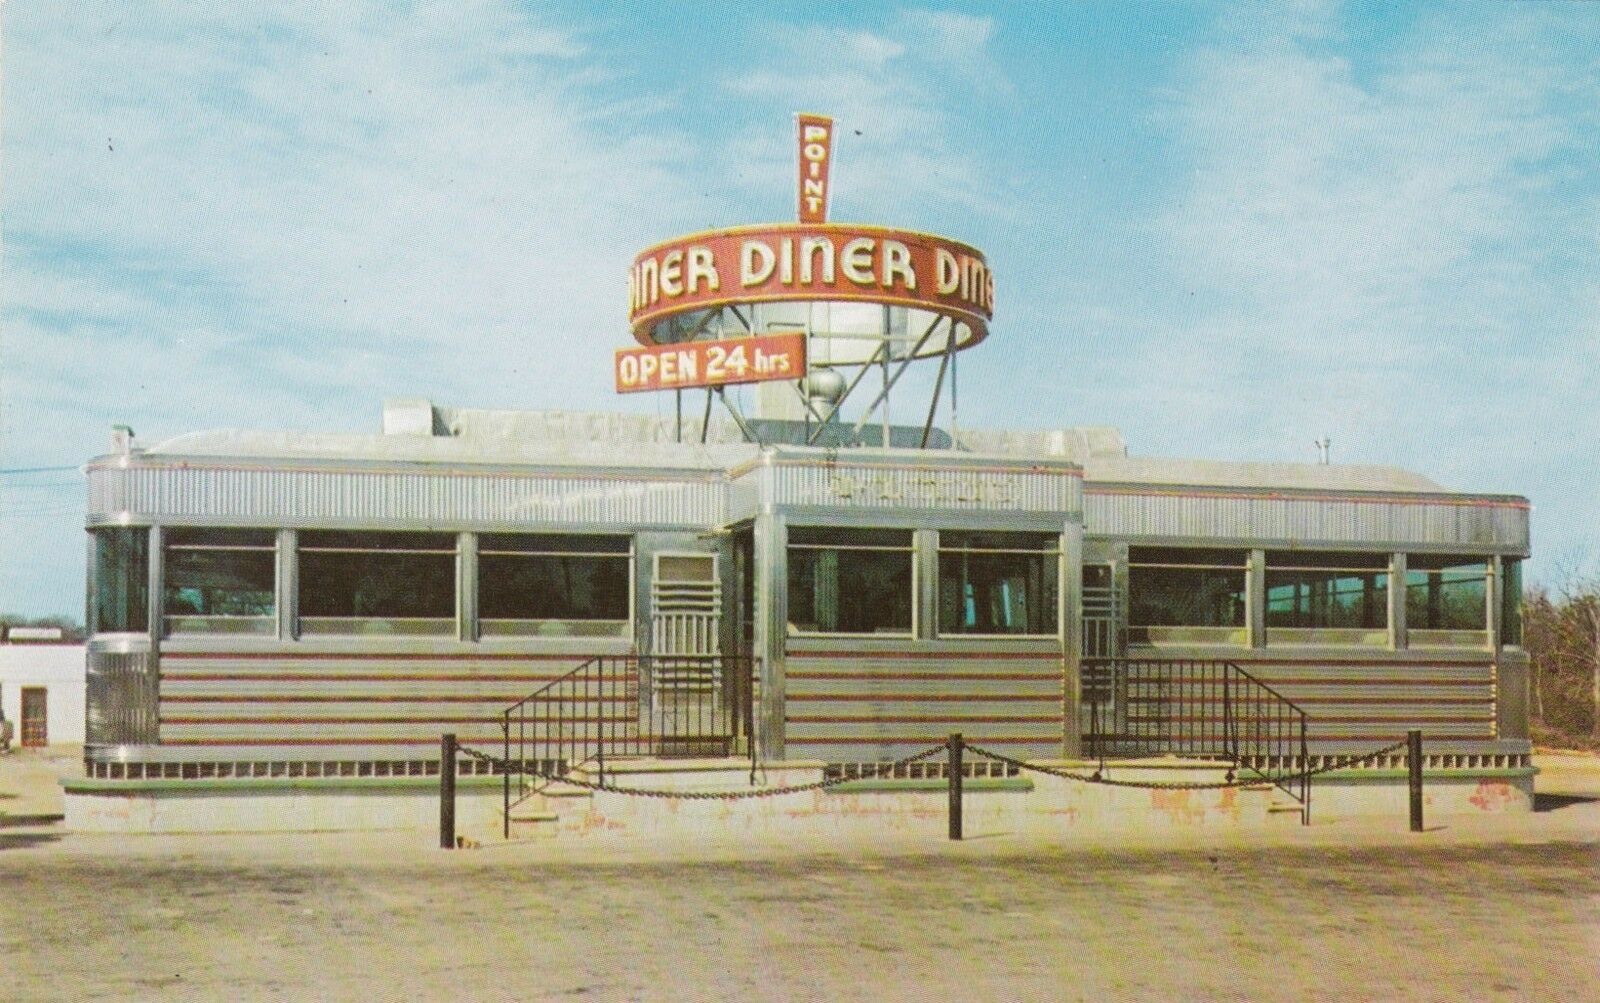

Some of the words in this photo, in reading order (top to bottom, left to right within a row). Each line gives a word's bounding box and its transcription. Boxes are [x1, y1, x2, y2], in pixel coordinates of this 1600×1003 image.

[804, 125, 827, 214] POINT
[740, 237, 916, 291] DINER
[619, 352, 699, 386] OPEN
[706, 345, 748, 377] 24
[755, 350, 791, 374] hrs
